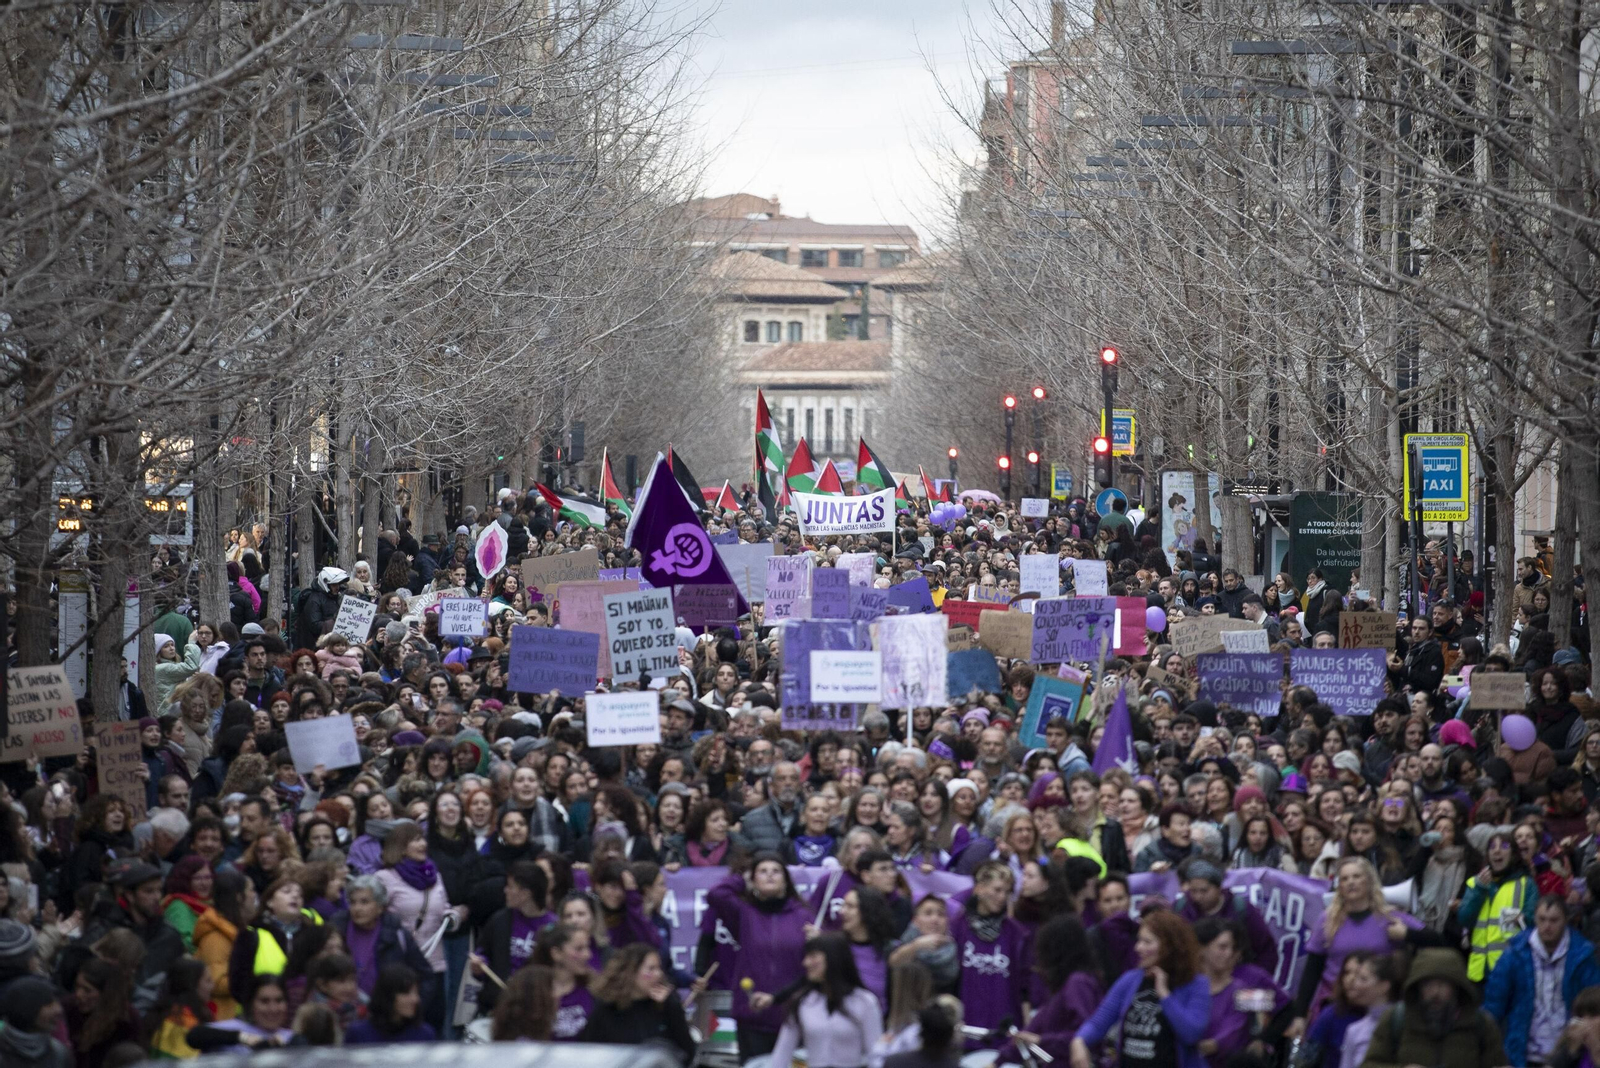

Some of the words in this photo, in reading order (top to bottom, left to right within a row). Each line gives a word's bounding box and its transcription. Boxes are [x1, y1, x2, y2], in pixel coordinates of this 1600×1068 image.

[1423, 479, 1454, 491] TAXI
[803, 495, 885, 525] JUNTAS
[831, 524, 859, 532] VIOLENCIAS
[859, 521, 886, 531] MACHISTAS
[1316, 548, 1328, 556] Da
[1328, 548, 1336, 556] la
[1337, 548, 1361, 556] vuelta
[553, 558, 573, 569] TU
[1323, 559, 1360, 567] disfrútalo
[343, 597, 369, 610] SUPORT
[445, 602, 460, 612] ERES
[461, 602, 482, 612] LIBRE
[607, 602, 623, 618] SI
[627, 595, 669, 614] MAÑANA
[1036, 601, 1049, 615] NO
[1049, 600, 1063, 612] SOY
[1065, 598, 1092, 611] TIERRA
[1094, 598, 1105, 611] DE
[450, 623, 473, 633] VUELA
[617, 620, 642, 635] SOY
[1045, 628, 1059, 642] SOY
[612, 637, 654, 654] QUIERO
[655, 633, 676, 648] SER
[1033, 641, 1069, 661] SEMILLA
[1069, 637, 1114, 660] FEMINISA
[615, 660, 632, 675] LA
[637, 653, 679, 673] ÚLTIMA
[1200, 655, 1248, 674] ABUELITA
[1297, 656, 1335, 671] NUNCA
[1347, 652, 1375, 671] MÁS
[24, 672, 63, 688] TAMBIÉN
[1163, 674, 1176, 684] NO
[1200, 676, 1210, 691] A
[1252, 679, 1264, 693] LO
[1295, 671, 1348, 685] TENDRÁN
[1352, 673, 1366, 685] LA
[843, 684, 877, 692] igualdad
[1309, 685, 1356, 694] ODIDAD
[1359, 686, 1374, 695] DE
[7, 691, 41, 706] GUSTAN
[43, 688, 62, 701] LAS
[8, 707, 46, 725] UJERES
[46, 707, 53, 721] Y
[58, 705, 75, 719] NO
[592, 726, 606, 734] Por
[609, 726, 617, 734] la
[619, 724, 655, 735] igualdad
[4, 733, 24, 749] LAS
[32, 730, 65, 745] ACOSO
